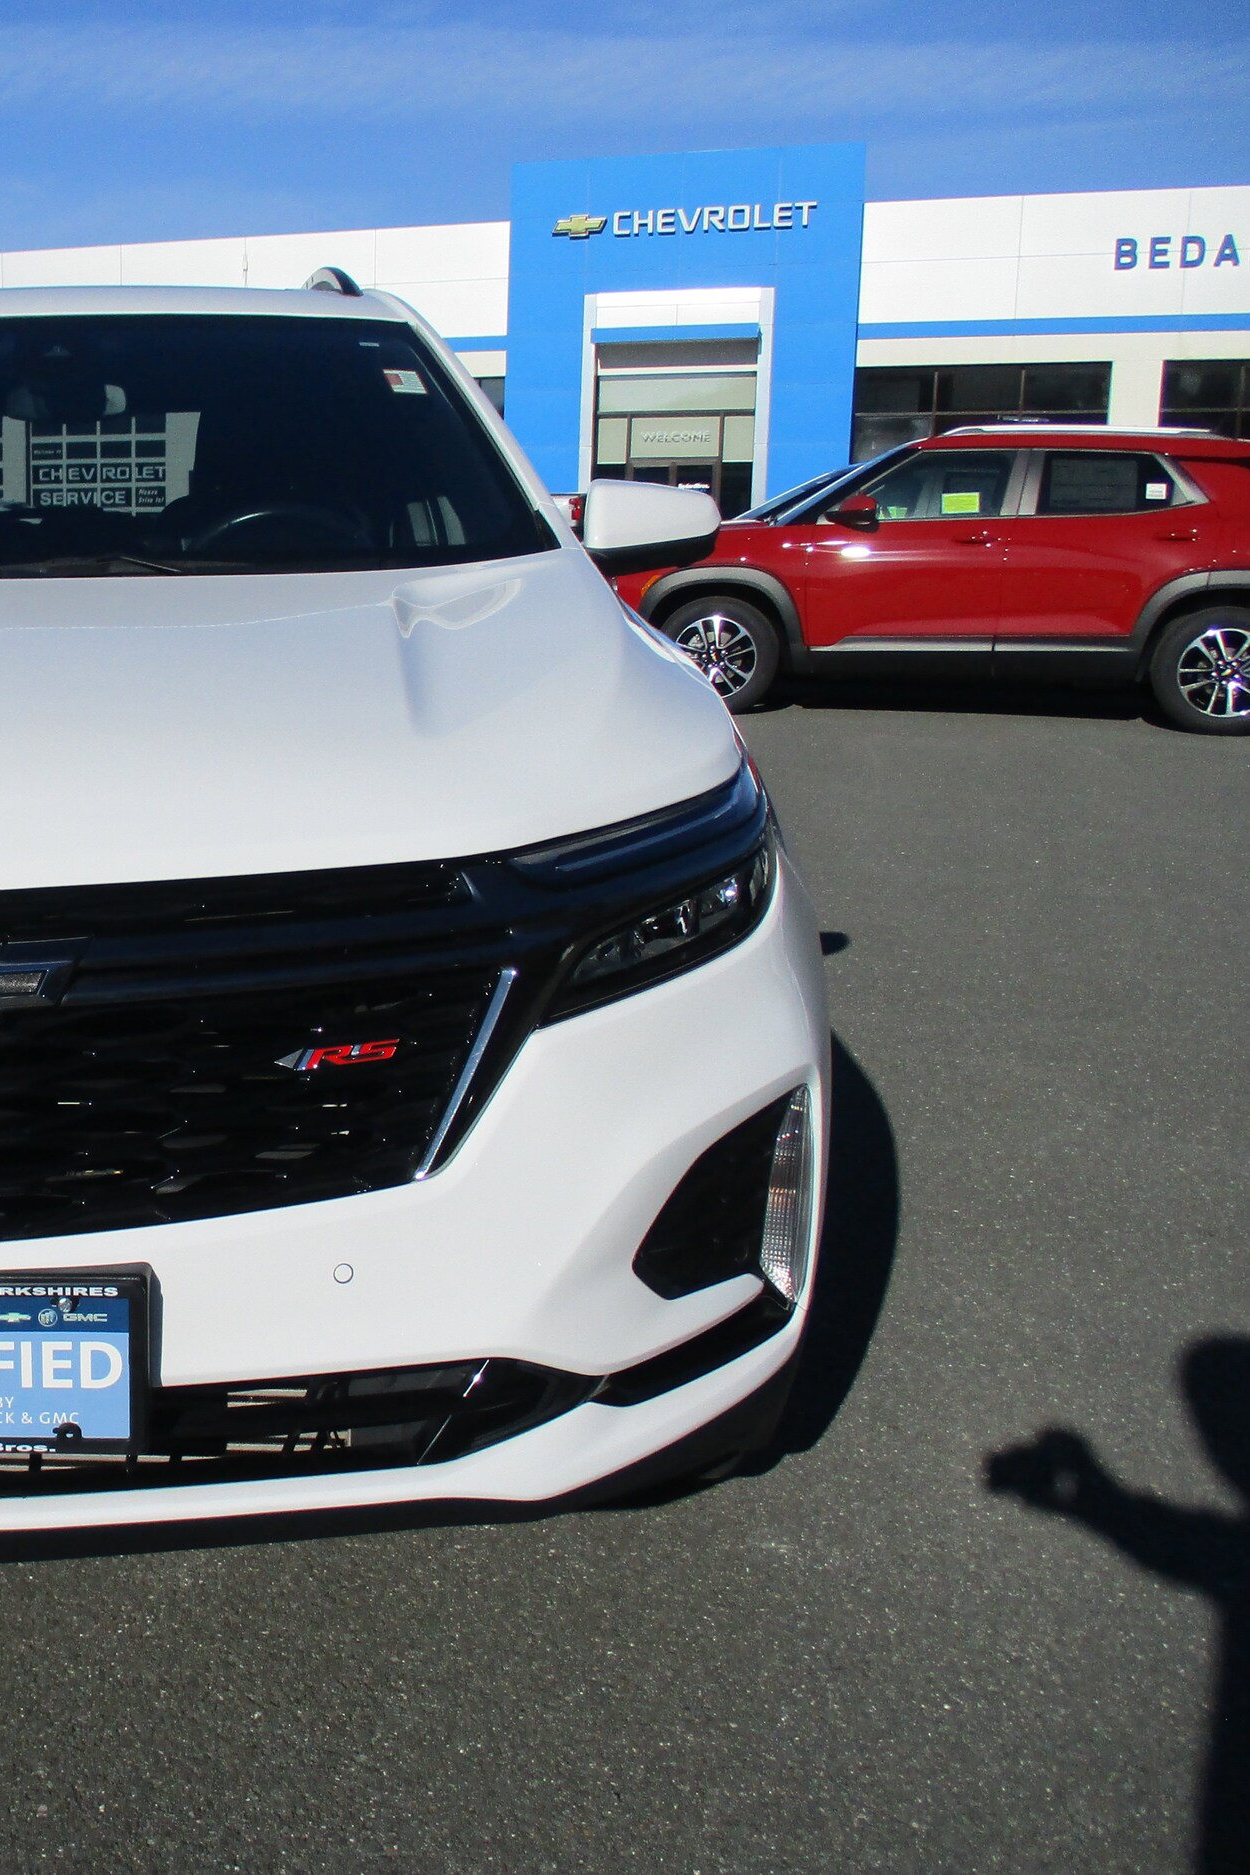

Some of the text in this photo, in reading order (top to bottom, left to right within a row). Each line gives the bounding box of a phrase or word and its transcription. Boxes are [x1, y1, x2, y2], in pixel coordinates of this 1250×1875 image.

[613, 201, 818, 236] CHEVROLET
[1114, 233, 1250, 270] BEDA
[641, 431, 711, 443] WELCOME
[39, 466, 166, 481] CHEVROLET
[40, 491, 126, 506] SERVICE
[306, 1039, 400, 1070] RS
[63, 1313, 108, 1322] GMC
[22, 1412, 33, 1425] &
[39, 1412, 80, 1425] GMC
